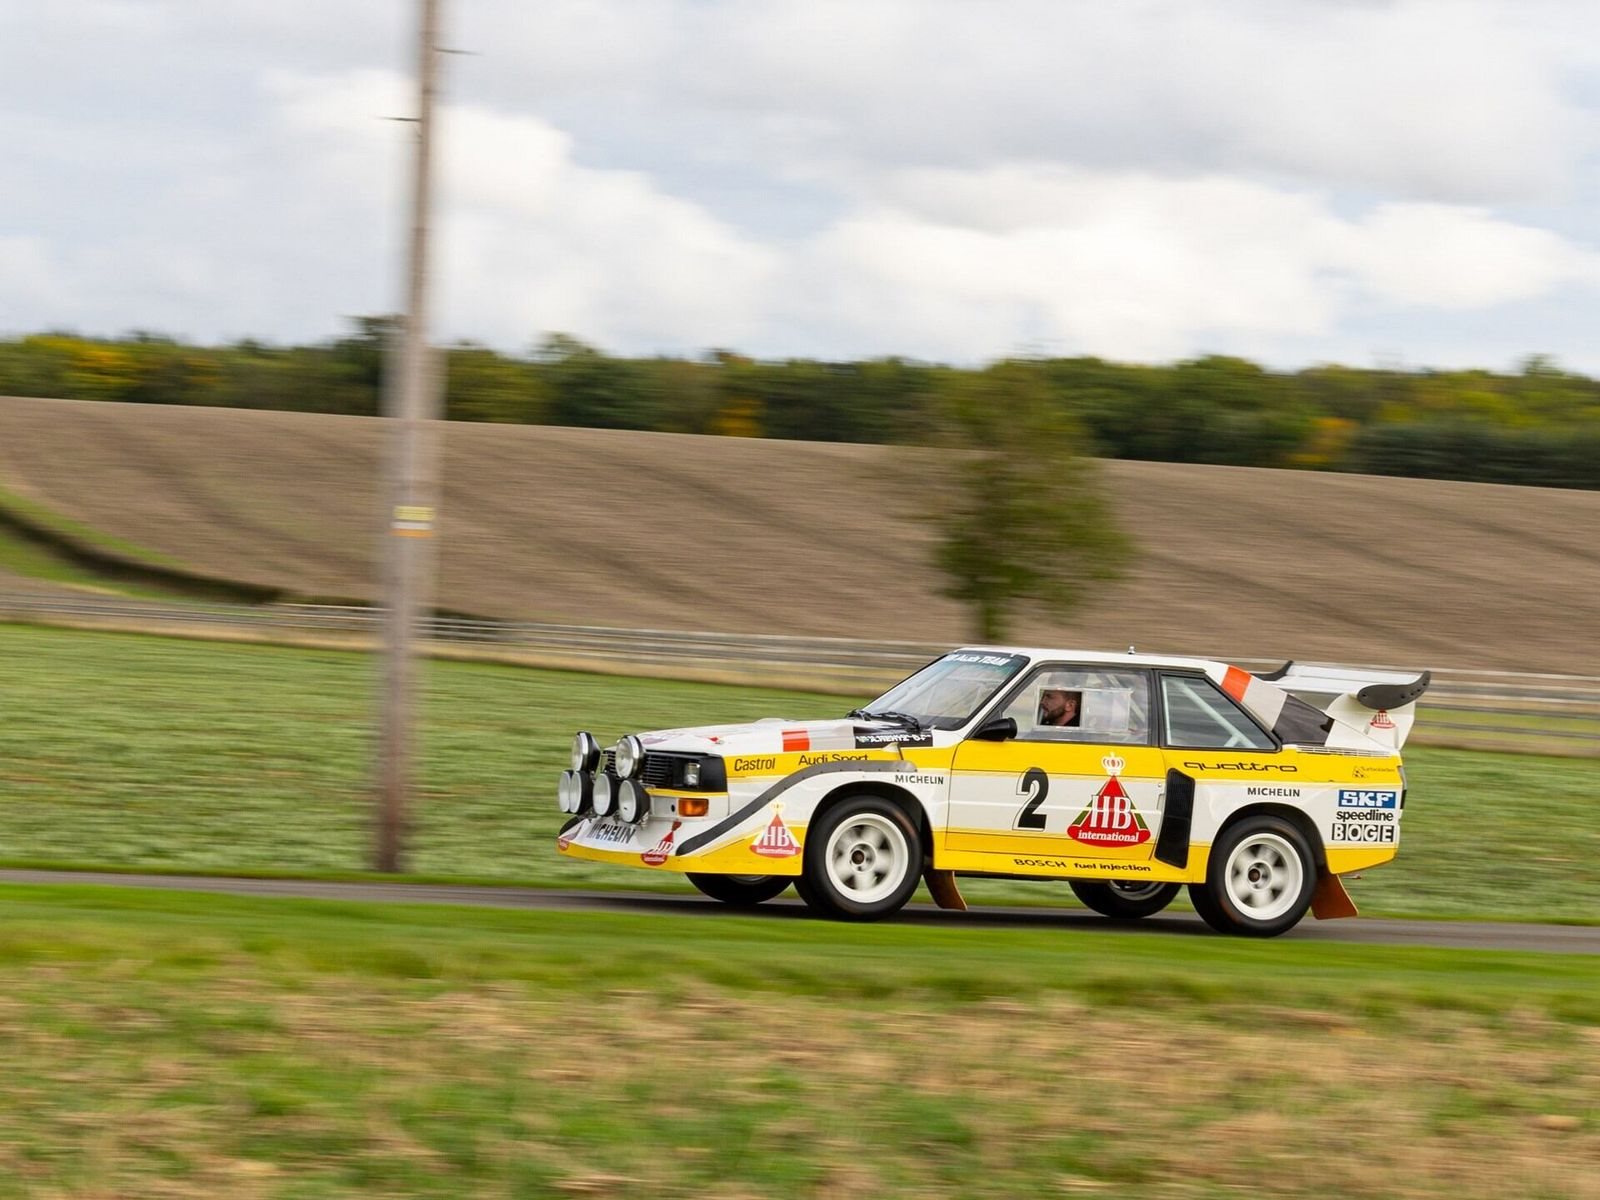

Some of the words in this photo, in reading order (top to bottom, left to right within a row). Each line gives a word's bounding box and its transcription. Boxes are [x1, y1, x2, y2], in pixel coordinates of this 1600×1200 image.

[734, 758, 776, 771] Castrol
[798, 754, 828, 766] Audi
[1184, 762, 1297, 772] quattro
[895, 774, 944, 785] MICHELIN
[1247, 787, 1301, 797] MICHELIN
[1012, 767, 1049, 831] 2
[1341, 791, 1394, 807] SKF
[1089, 795, 1132, 829] HB
[1336, 809, 1394, 822] speedline
[762, 826, 790, 847] HB
[1077, 830, 1139, 843] international
[1332, 823, 1394, 842] BOGE
[1013, 859, 1067, 868] BOSCH
[1074, 862, 1097, 870] fuel
[1100, 863, 1152, 872] injection
